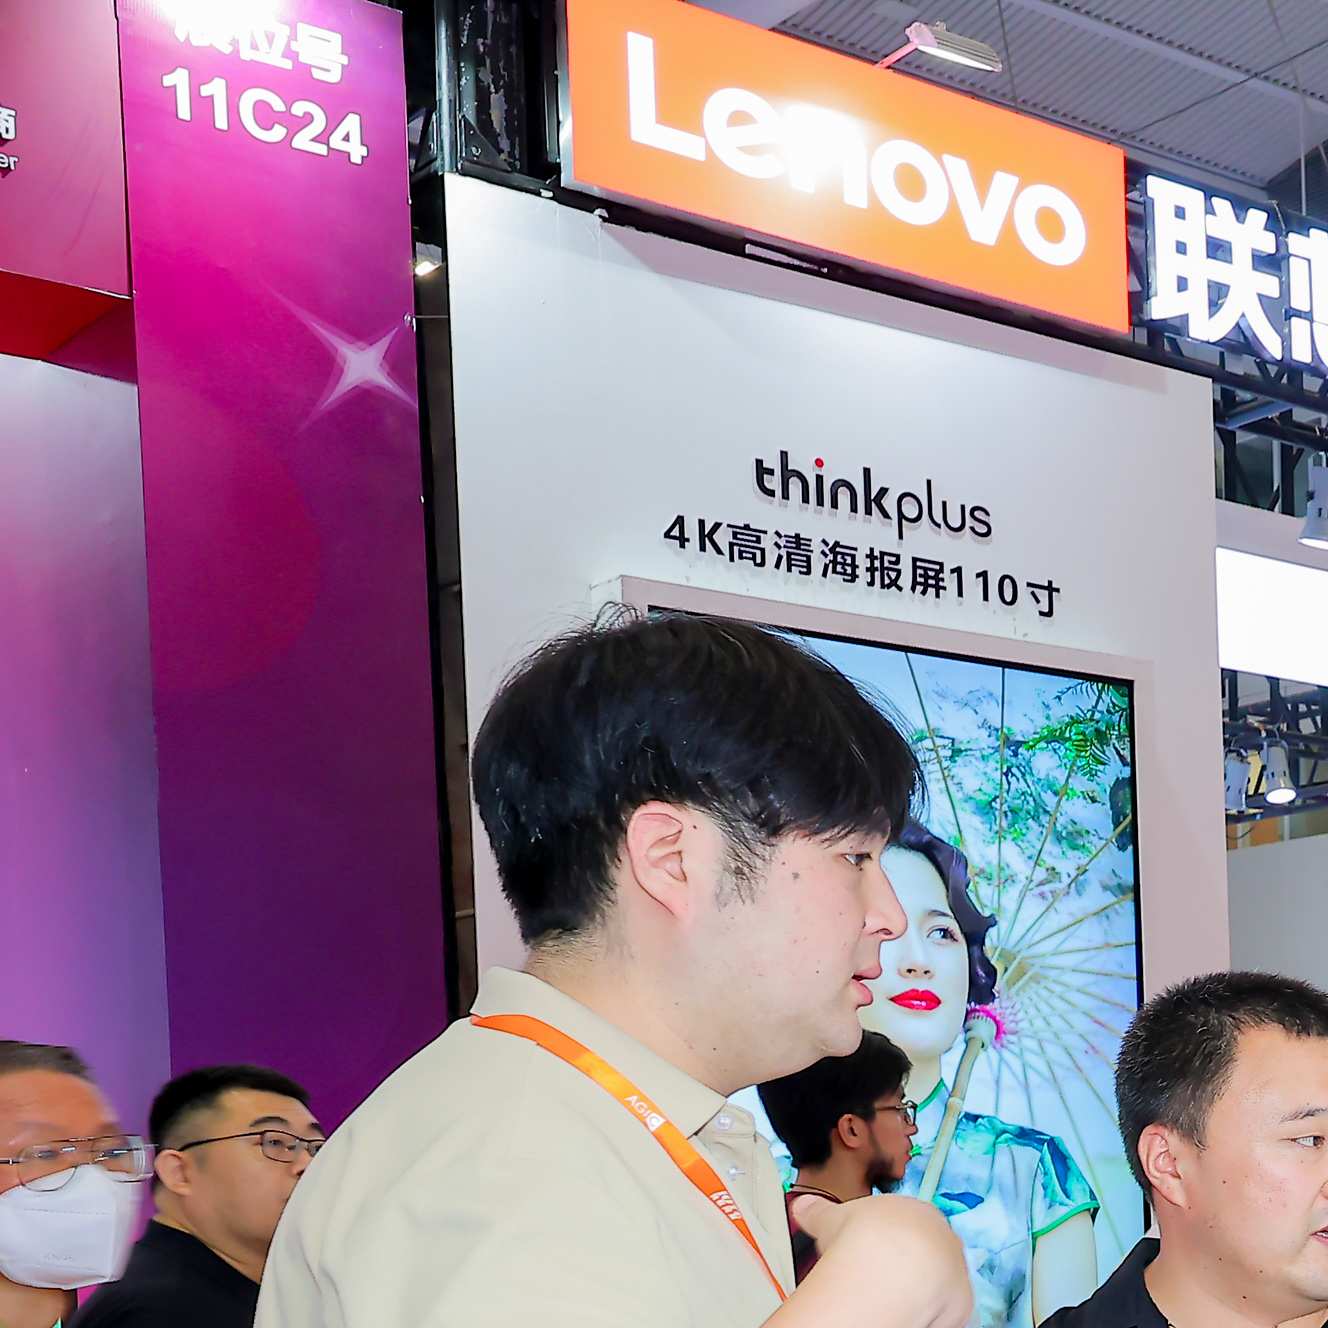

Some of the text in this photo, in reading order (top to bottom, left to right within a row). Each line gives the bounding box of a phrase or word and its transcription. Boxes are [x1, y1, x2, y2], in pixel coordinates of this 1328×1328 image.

[161, 66, 369, 166] 11C24
[626, 31, 1087, 268] Lenovo
[754, 449, 993, 541] thinkplus
